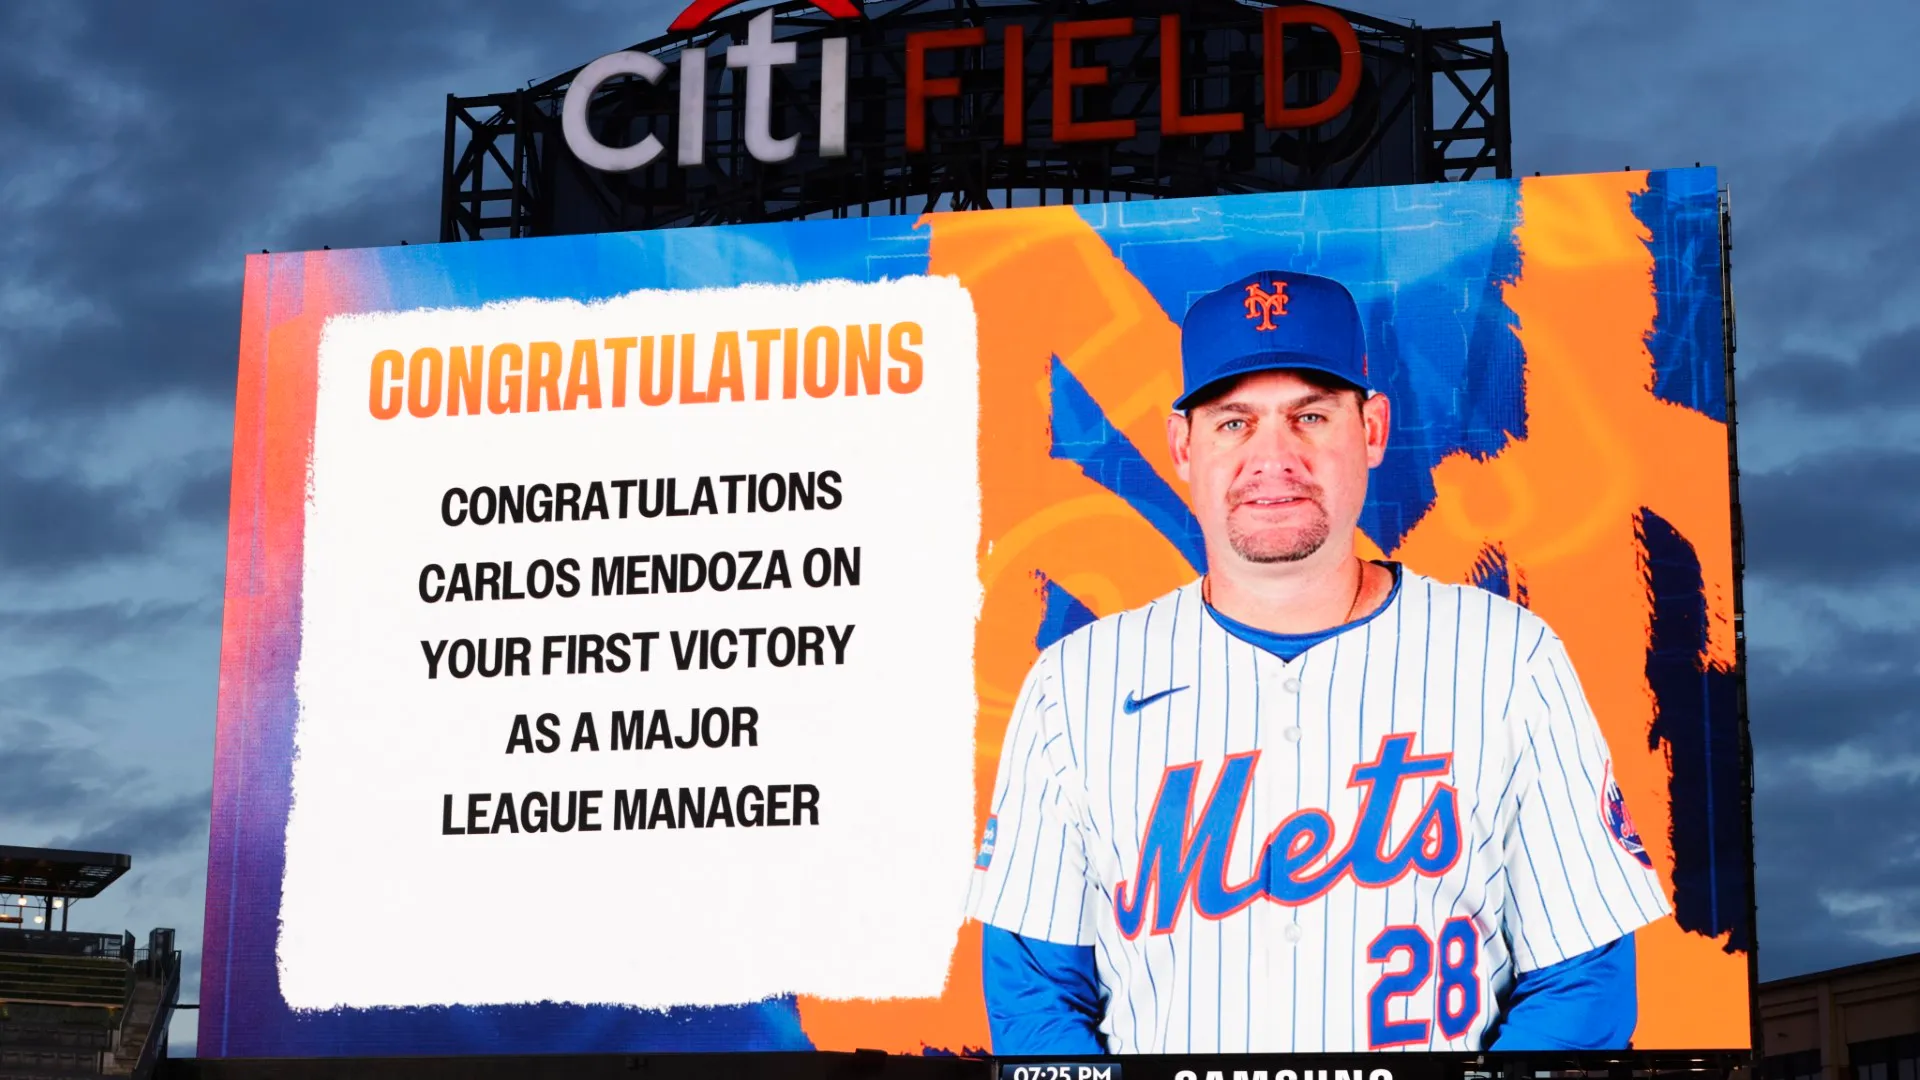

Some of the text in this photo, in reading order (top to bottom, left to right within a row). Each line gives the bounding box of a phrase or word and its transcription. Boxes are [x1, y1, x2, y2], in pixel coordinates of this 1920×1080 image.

[562, 4, 1362, 171] citi FIELD
[369, 321, 924, 421] CONGRATULATIONS
[441, 470, 843, 527] CONGRATULATIONS
[418, 546, 861, 604] CARLOS MENDOZA ON
[420, 624, 856, 680] YOUR FIRST VICTORY
[505, 706, 759, 755] AS A MAJOR
[442, 783, 820, 836] LEAGUE MANAGER
[1114, 731, 1464, 941] Mets
[1366, 915, 1482, 1050] 28
[1078, 1065, 1112, 1080] PM
